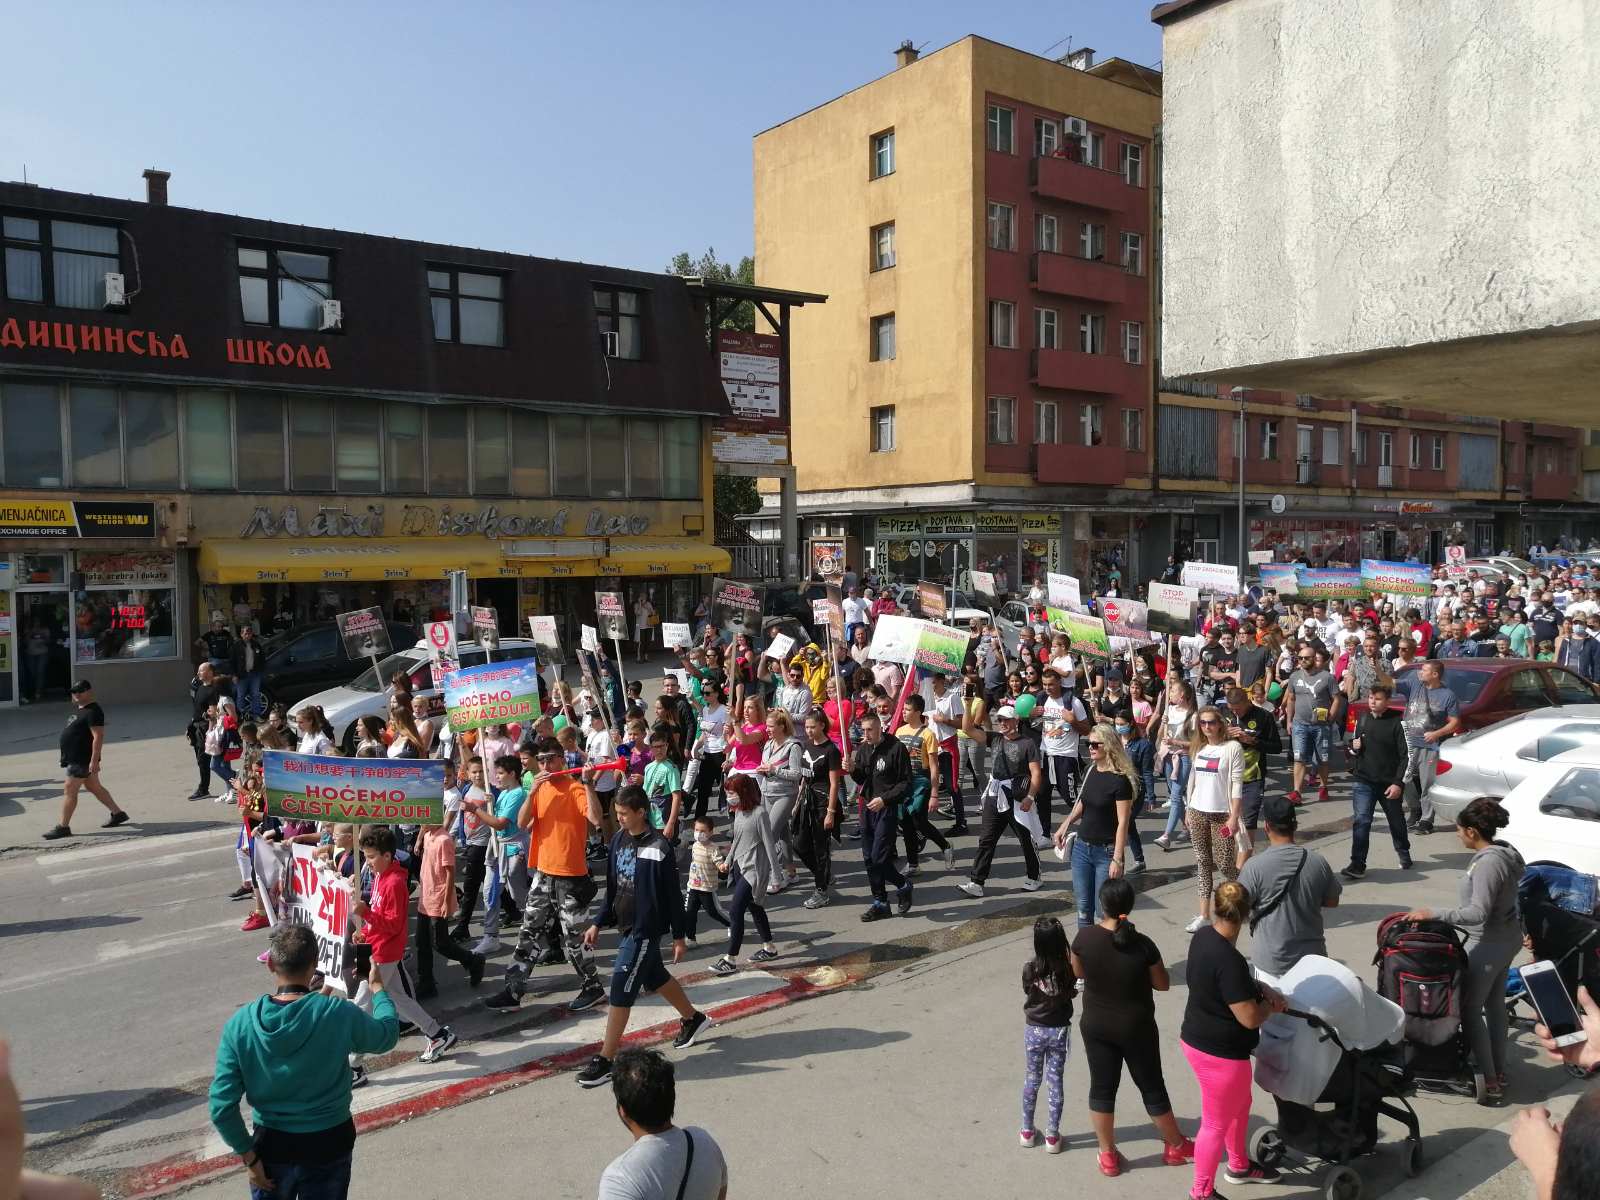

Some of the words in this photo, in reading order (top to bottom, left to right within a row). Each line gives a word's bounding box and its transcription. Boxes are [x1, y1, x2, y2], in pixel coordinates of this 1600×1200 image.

[225, 338, 332, 369] ШКОЛА
[891, 519, 921, 532] PIZZA
[1022, 519, 1045, 529] PIZZA
[305, 784, 406, 803] HOĆEMO
[281, 795, 335, 817] ČIST
[339, 803, 431, 818] VAZDUH
